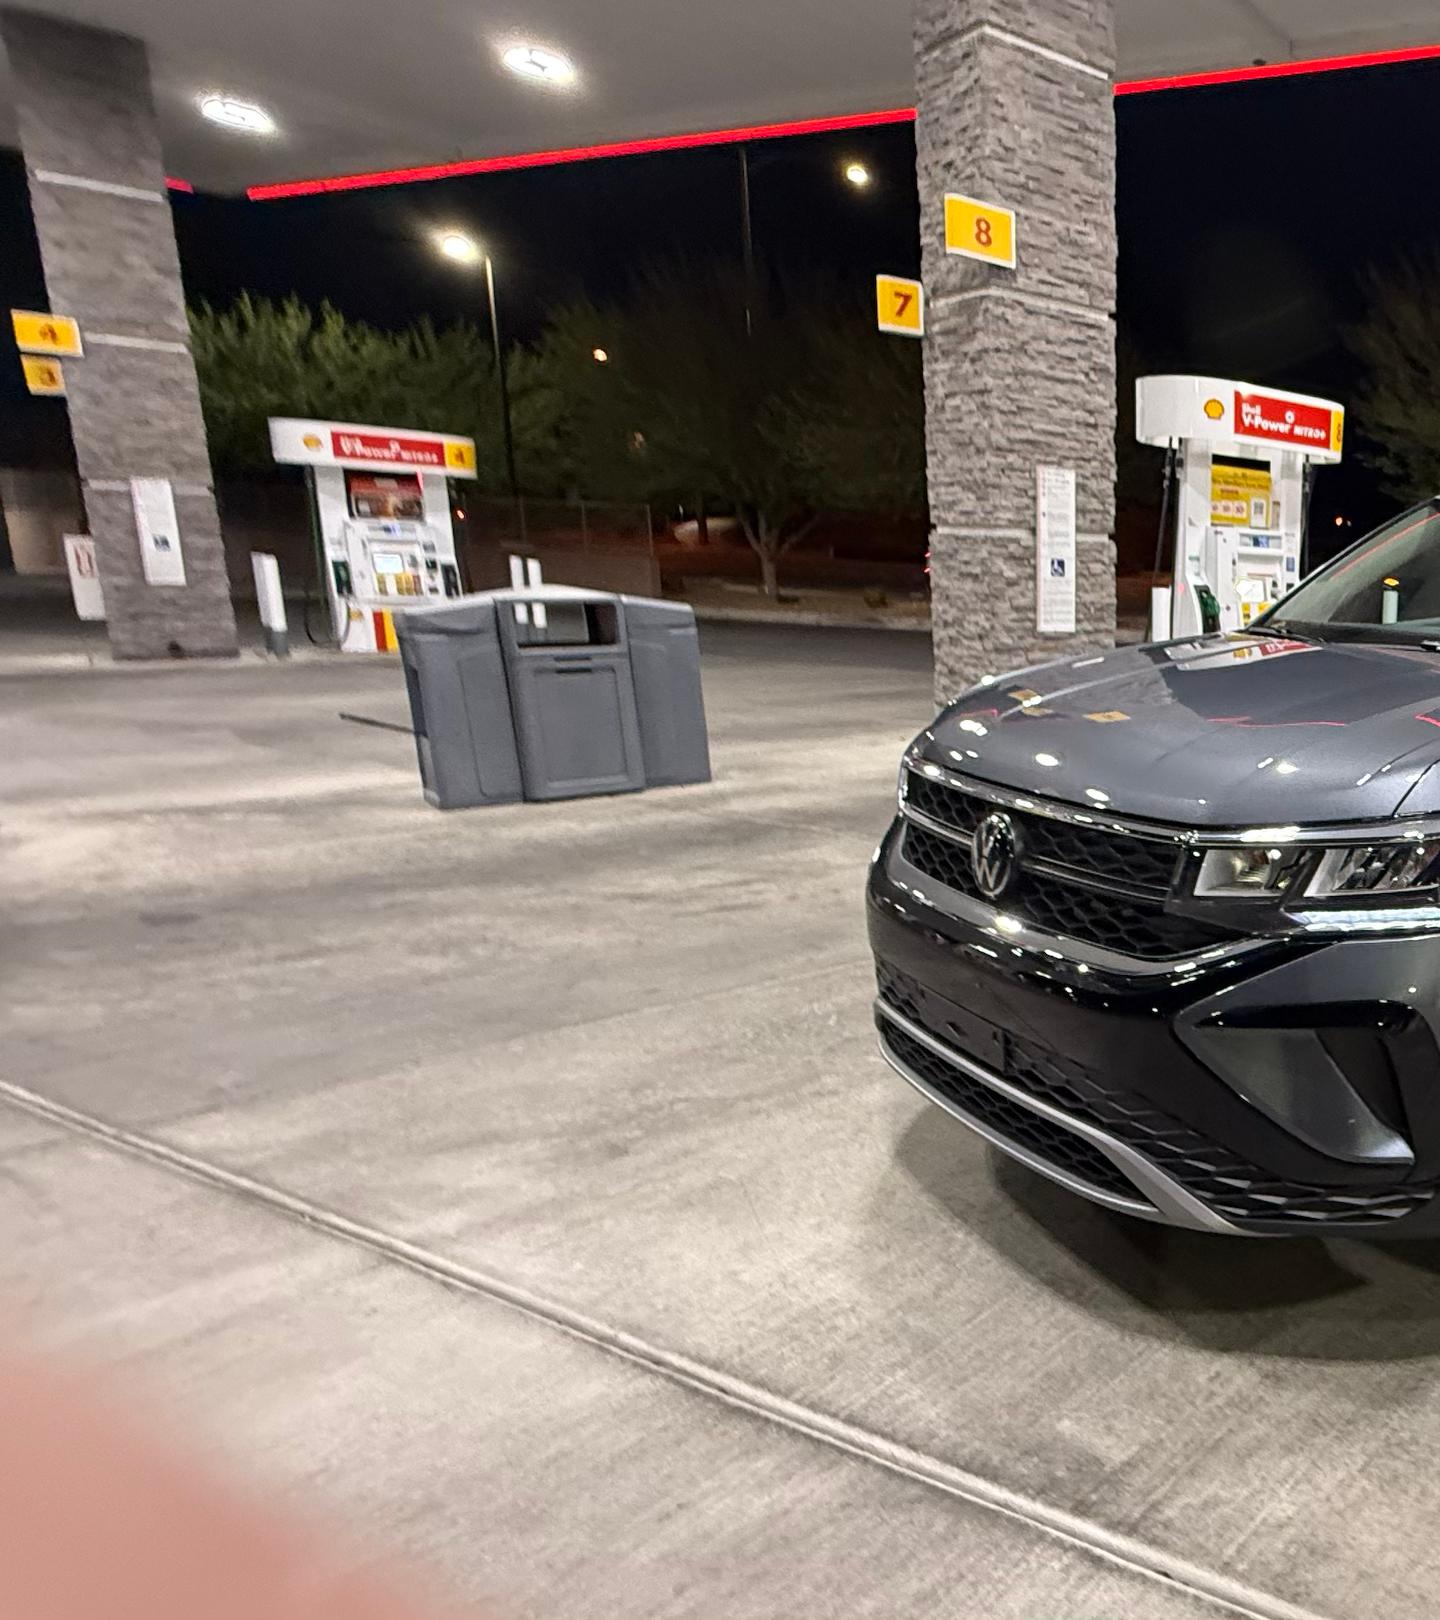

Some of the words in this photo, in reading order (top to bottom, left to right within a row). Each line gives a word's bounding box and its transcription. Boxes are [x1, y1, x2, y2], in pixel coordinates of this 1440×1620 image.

[974, 217, 992, 247] 8
[893, 291, 913, 318] 7
[1242, 413, 1291, 434] V-Power
